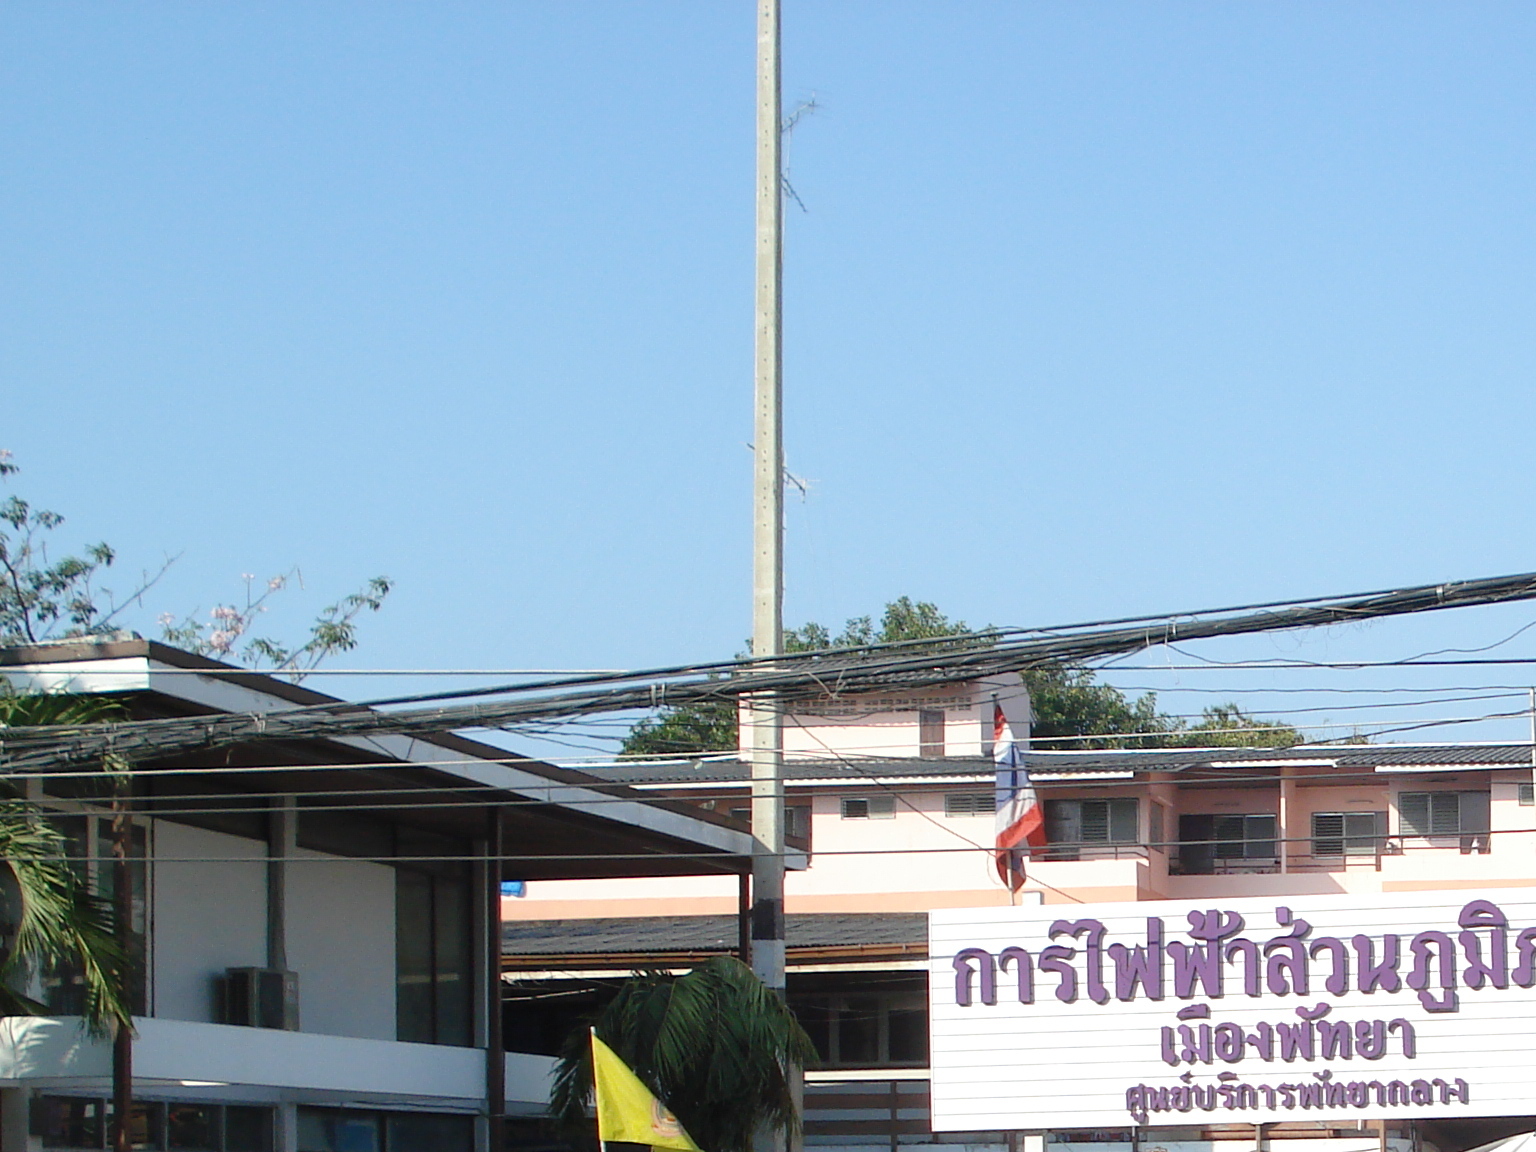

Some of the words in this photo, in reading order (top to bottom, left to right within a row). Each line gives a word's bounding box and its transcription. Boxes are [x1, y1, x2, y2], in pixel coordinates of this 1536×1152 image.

[1160, 1002, 1417, 1066] เมืองพัทยา
[1126, 1069, 1470, 1122] ศูนย์บริการพัทยากลาง
